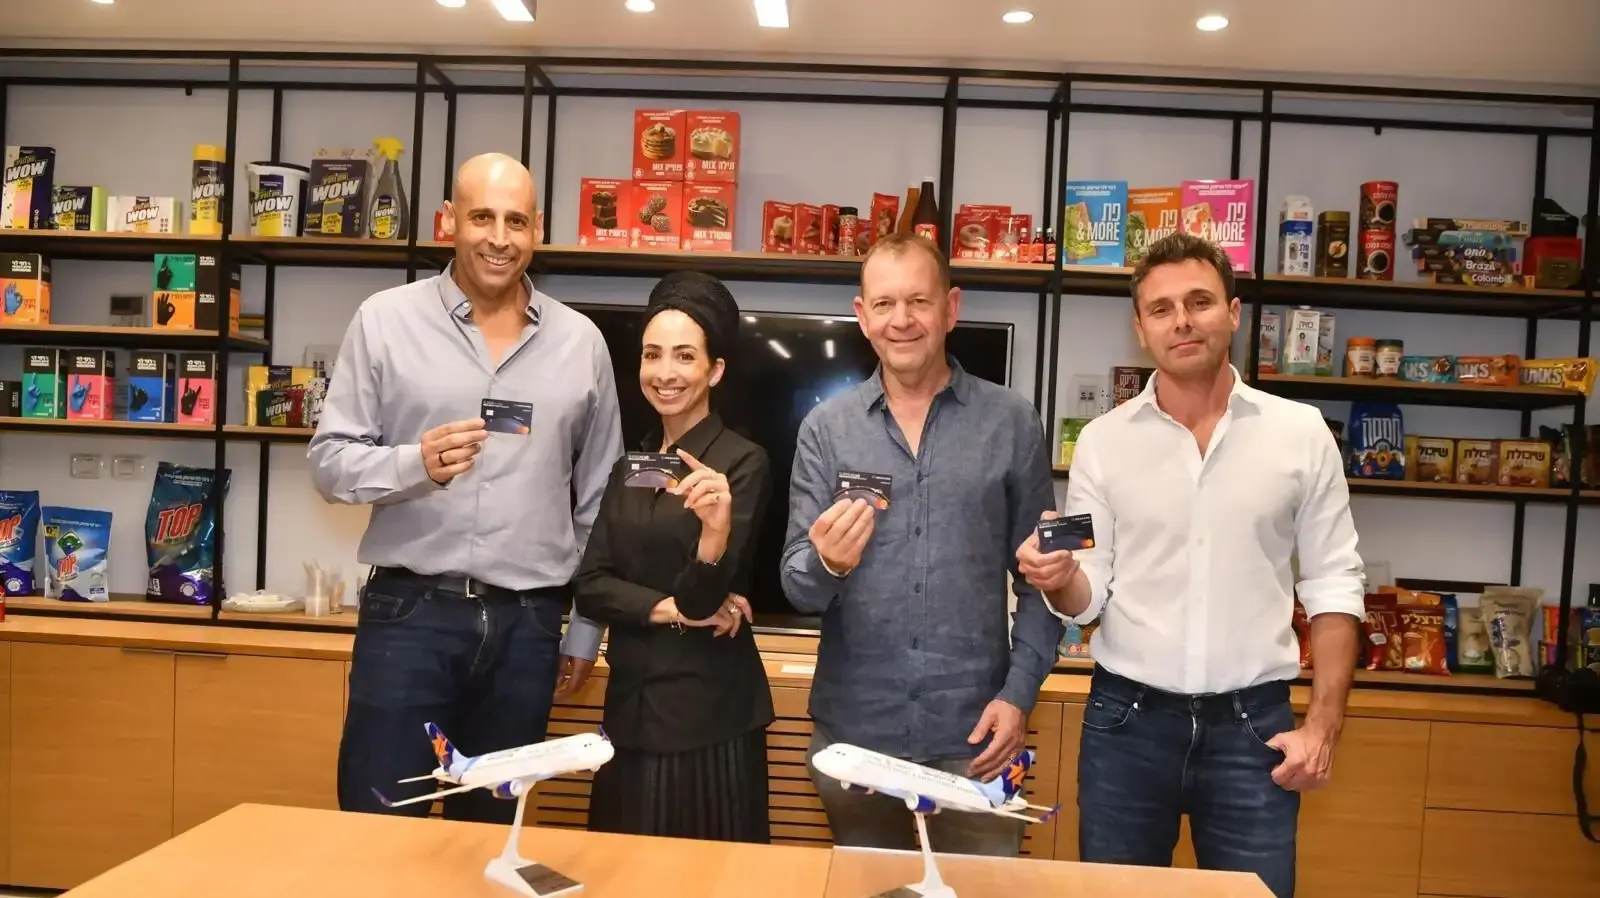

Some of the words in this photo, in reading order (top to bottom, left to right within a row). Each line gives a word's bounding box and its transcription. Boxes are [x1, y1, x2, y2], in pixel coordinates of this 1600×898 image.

[7, 160, 47, 182] WOW
[702, 161, 716, 170] MIX
[311, 178, 362, 203] WOW
[53, 197, 87, 215] WOW
[126, 206, 160, 224] WOW
[253, 196, 293, 217] WOW
[375, 207, 395, 218] WOW
[1101, 203, 1121, 222] פת
[1226, 202, 1247, 222] פת
[1158, 209, 1178, 228] פת
[1077, 221, 1085, 240] &
[1087, 222, 1120, 241] MORE
[1133, 229, 1143, 248] &
[1144, 228, 1177, 247] MOR
[1201, 222, 1209, 240] &
[1211, 222, 1246, 242] MORE
[1465, 260, 1496, 271] Brazil
[265, 401, 293, 417] WOW
[0, 514, 22, 542] OP
[157, 503, 202, 542] TOP
[57, 554, 76, 578] TOP
